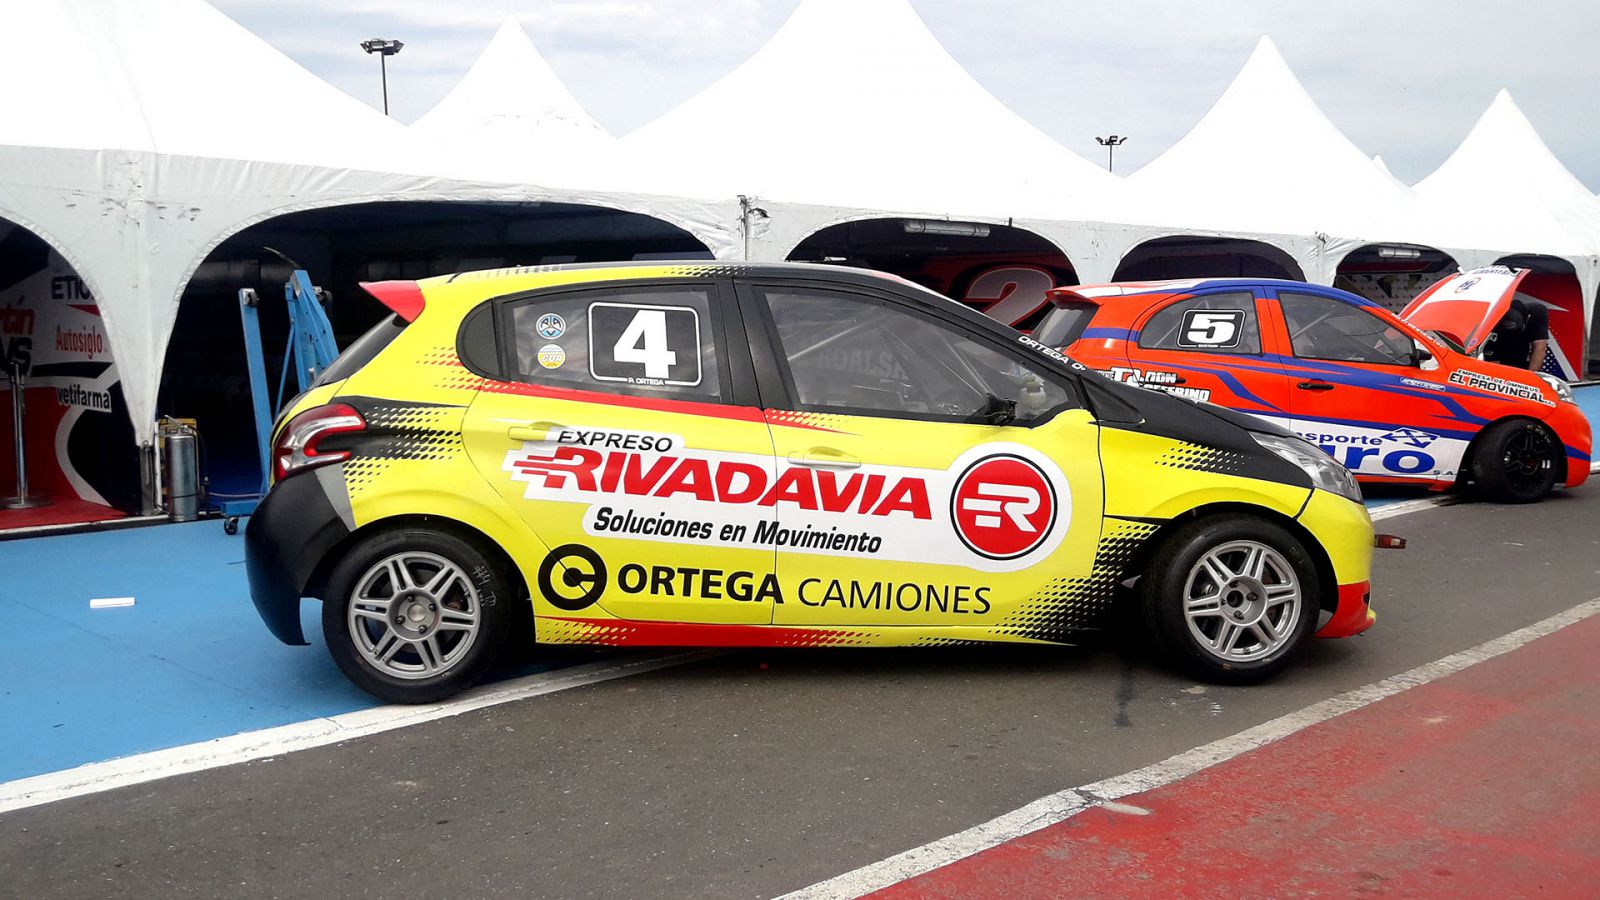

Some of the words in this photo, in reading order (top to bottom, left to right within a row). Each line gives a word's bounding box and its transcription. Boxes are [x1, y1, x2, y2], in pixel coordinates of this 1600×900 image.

[56, 325, 103, 360] Autosiglo
[1187, 313, 1236, 344] 5
[613, 309, 677, 379] 4
[1017, 335, 1069, 364] ORTEGA
[636, 378, 665, 386] ORTEGA
[1449, 373, 1465, 384] EL
[1469, 378, 1545, 403] PROVINCIAL
[1458, 369, 1492, 382] EMPRESA
[1506, 381, 1539, 393] OMNIBUS
[57, 384, 112, 410] vetifarma
[558, 430, 673, 452] EXPRESO
[1296, 432, 1383, 446] sporte
[514, 447, 932, 520] RIVADAVIA
[593, 506, 713, 540] Soluciones
[719, 523, 745, 542] en
[753, 520, 882, 554] Movimiento
[617, 563, 785, 605] ORTEGA
[798, 578, 991, 615] CAMIONES
